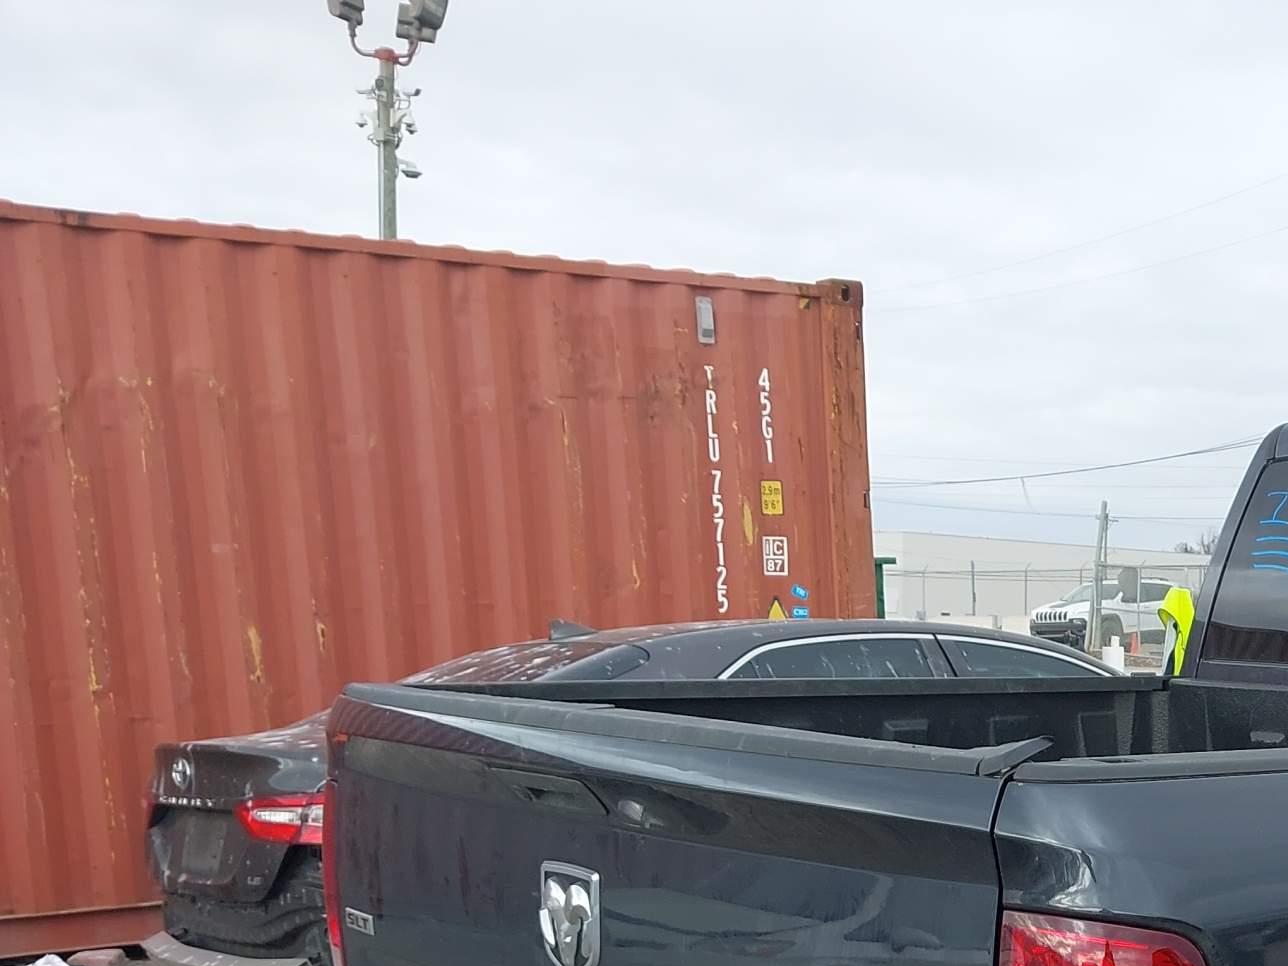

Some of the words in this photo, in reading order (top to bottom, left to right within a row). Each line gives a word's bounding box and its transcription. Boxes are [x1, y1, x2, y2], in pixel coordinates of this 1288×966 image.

[703, 365, 720, 462] TRLU
[758, 367, 773, 463] 45G1
[766, 559, 783, 572] 87
